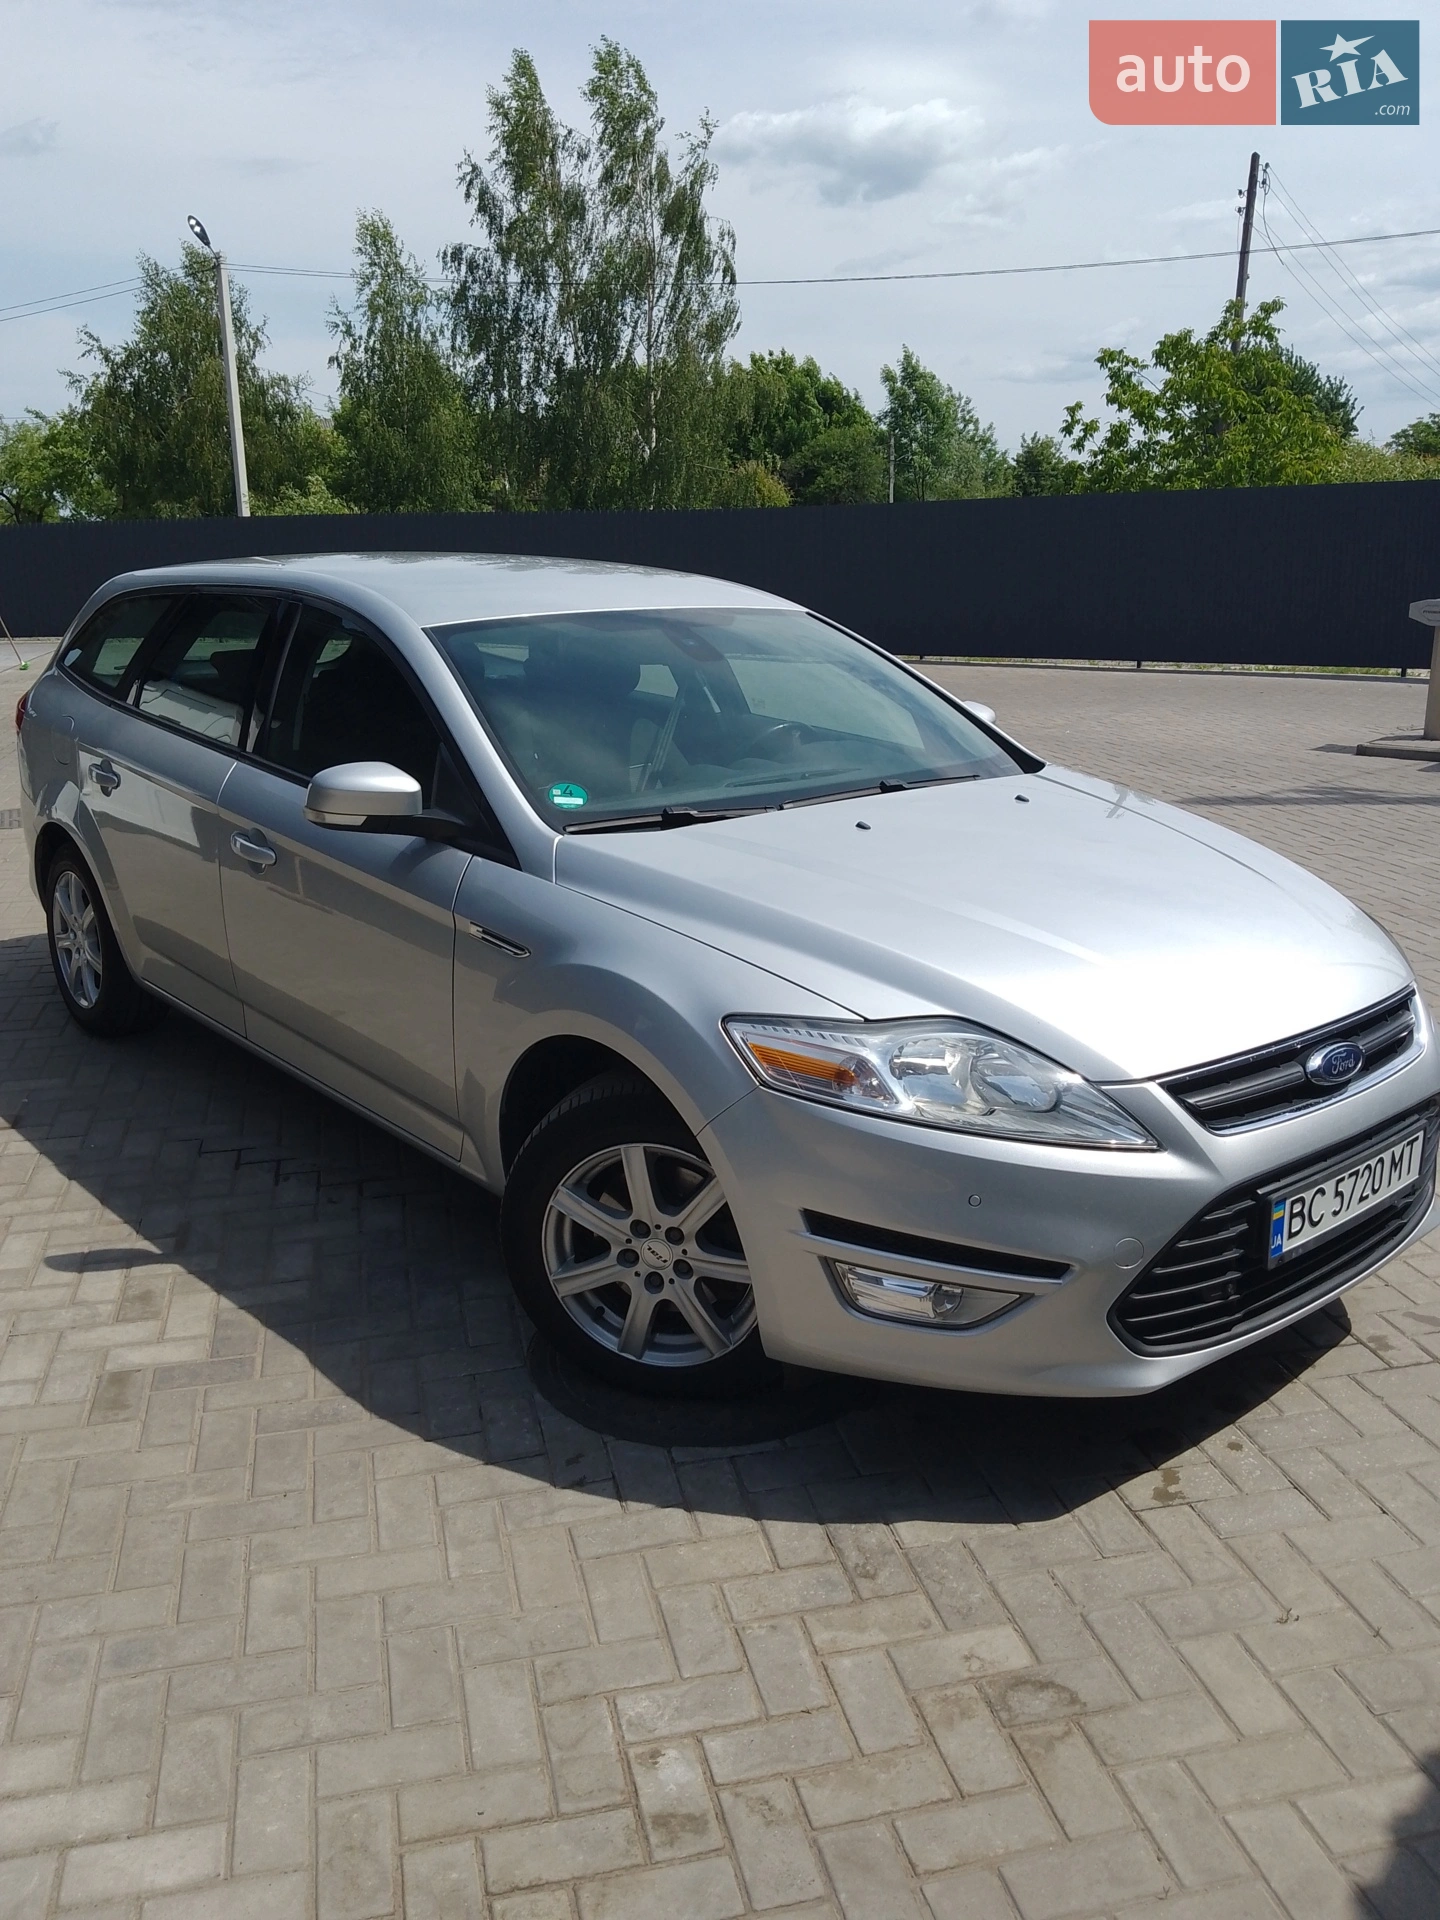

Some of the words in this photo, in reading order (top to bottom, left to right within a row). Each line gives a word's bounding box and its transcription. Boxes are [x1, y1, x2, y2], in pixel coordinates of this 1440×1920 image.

[1331, 1052, 1355, 1075] Ford
[1287, 1186, 1327, 1241] BC
[1331, 1156, 1385, 1218] 5720
[1387, 1135, 1420, 1188] MT
